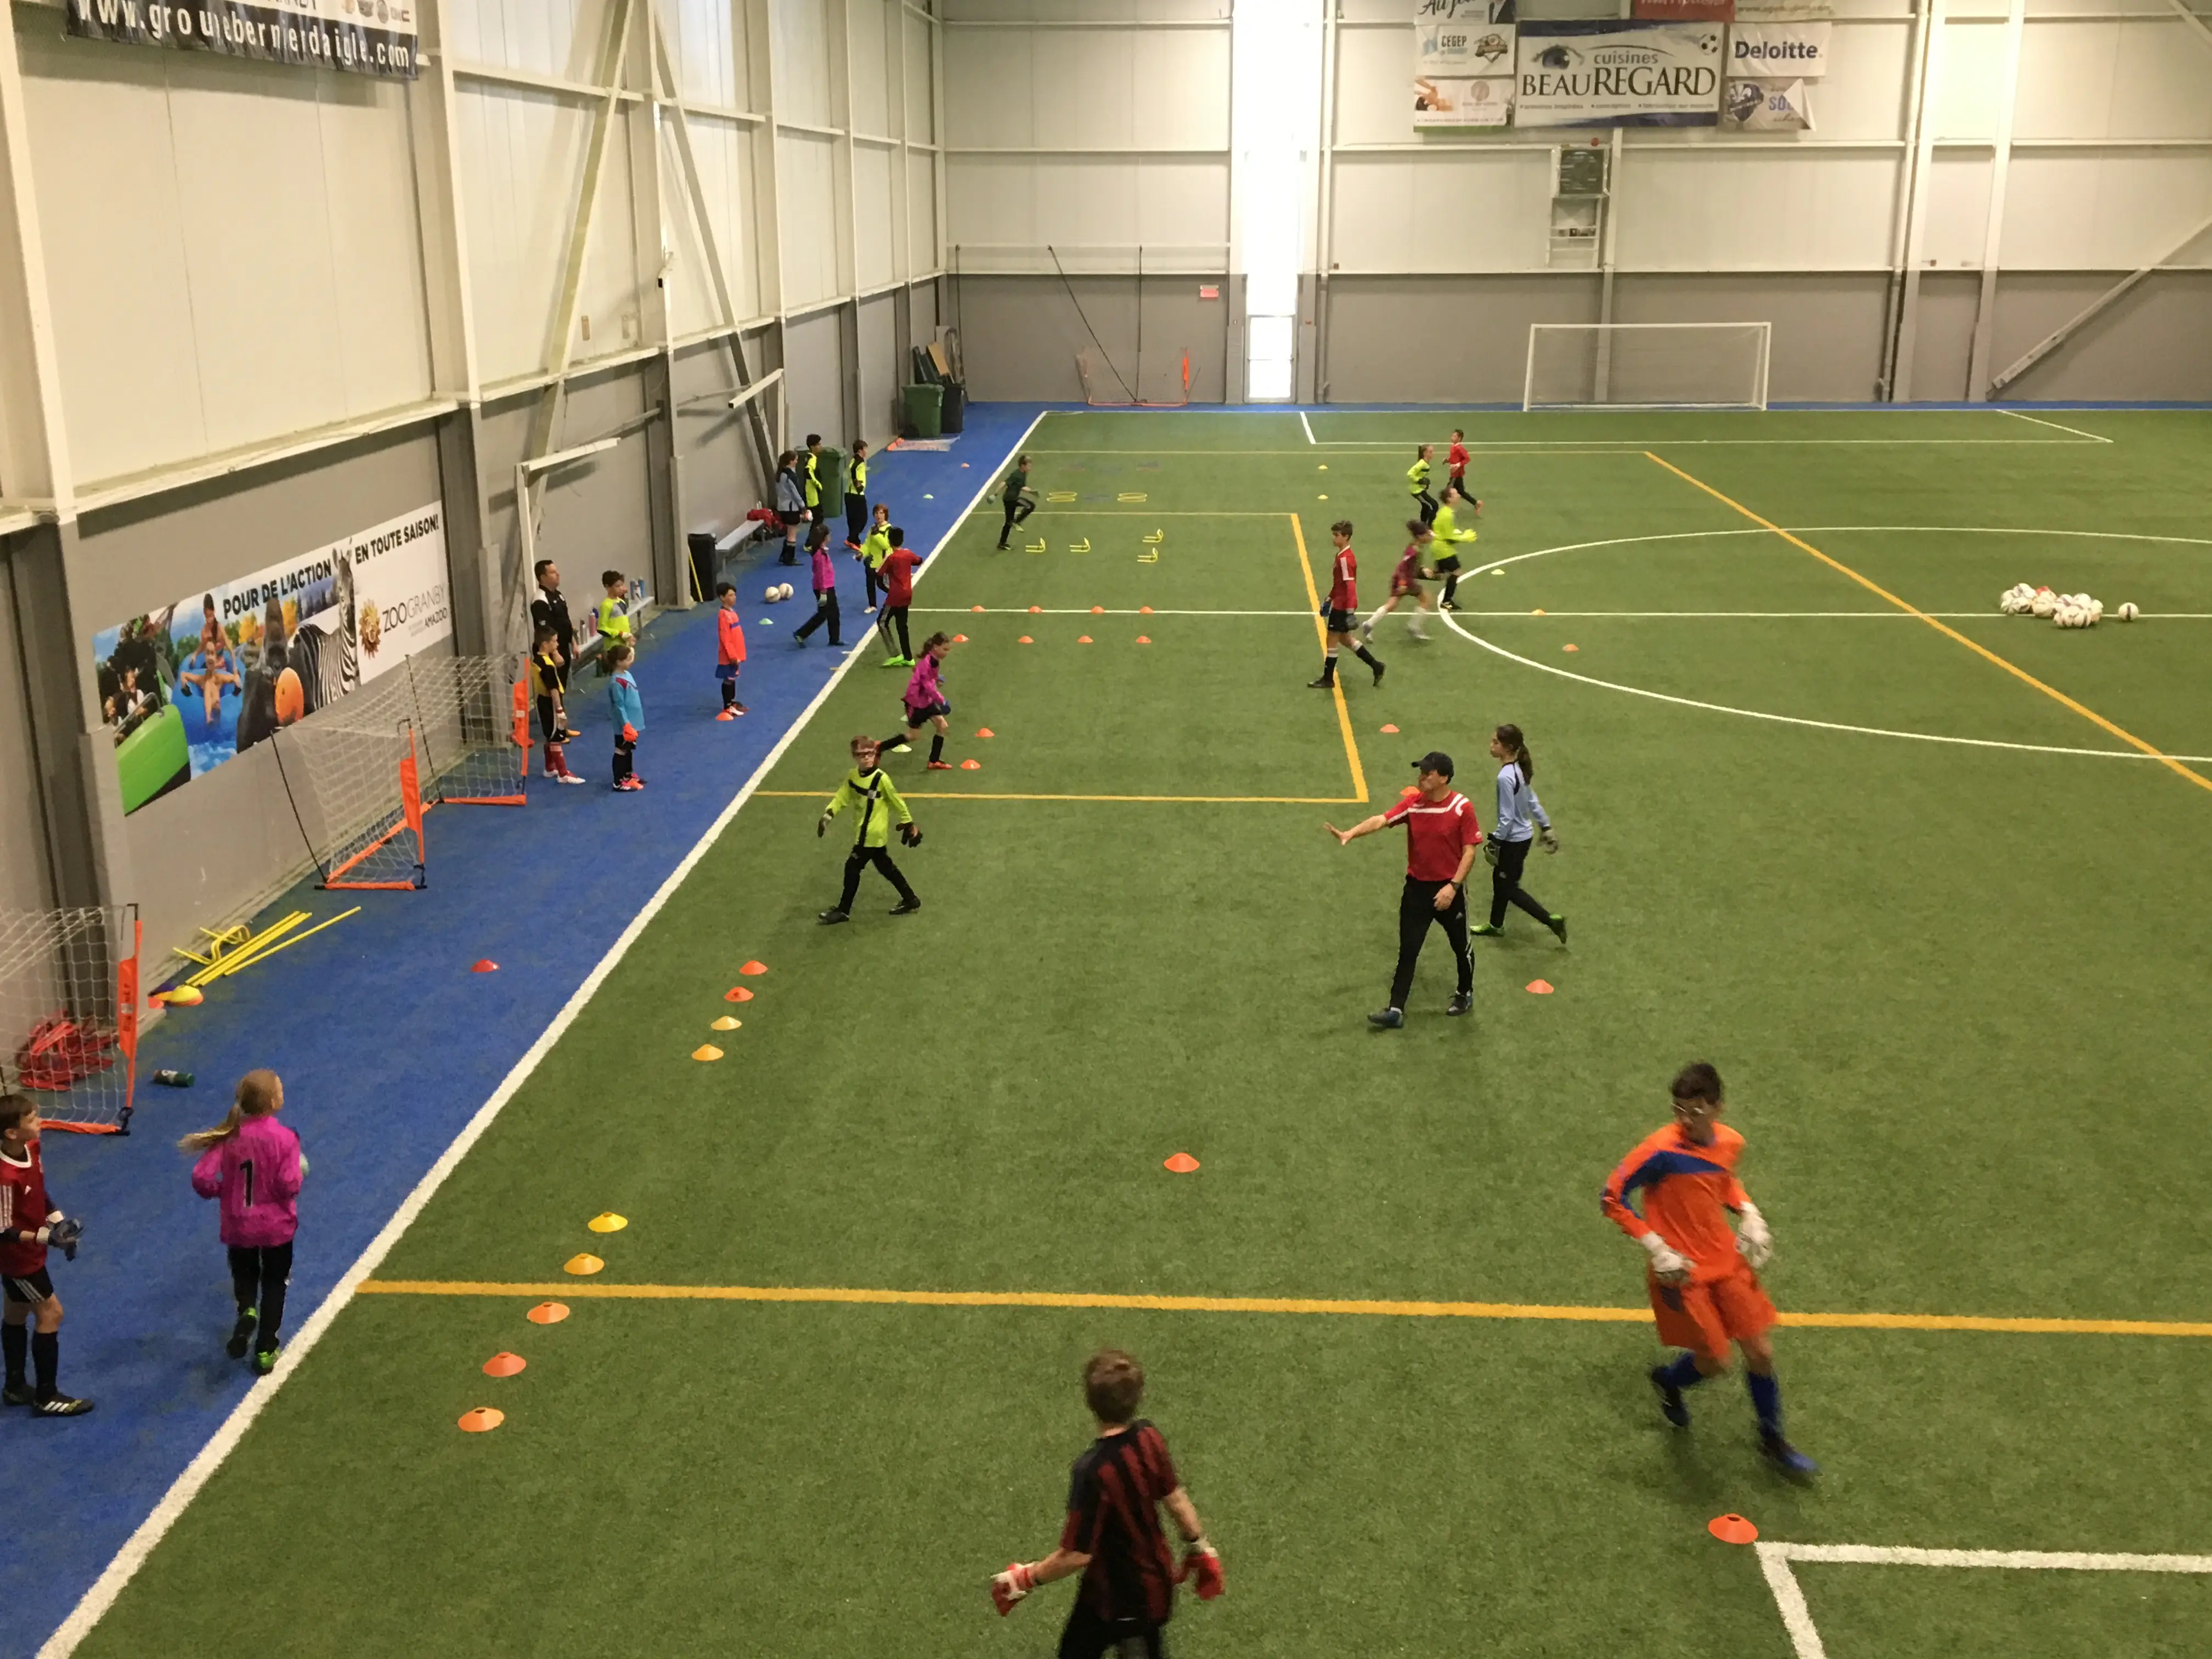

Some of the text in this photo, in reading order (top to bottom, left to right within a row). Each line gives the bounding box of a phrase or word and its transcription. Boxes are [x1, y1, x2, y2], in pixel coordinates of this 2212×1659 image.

[1594, 50, 1658, 64] cuisines
[1521, 66, 1716, 96] BEAUREGARD
[223, 514, 439, 619] POUR DE L'ACTION EN TOUTE SAISON!
[425, 607, 448, 628] AMAZOO
[239, 1159, 255, 1208] 1
